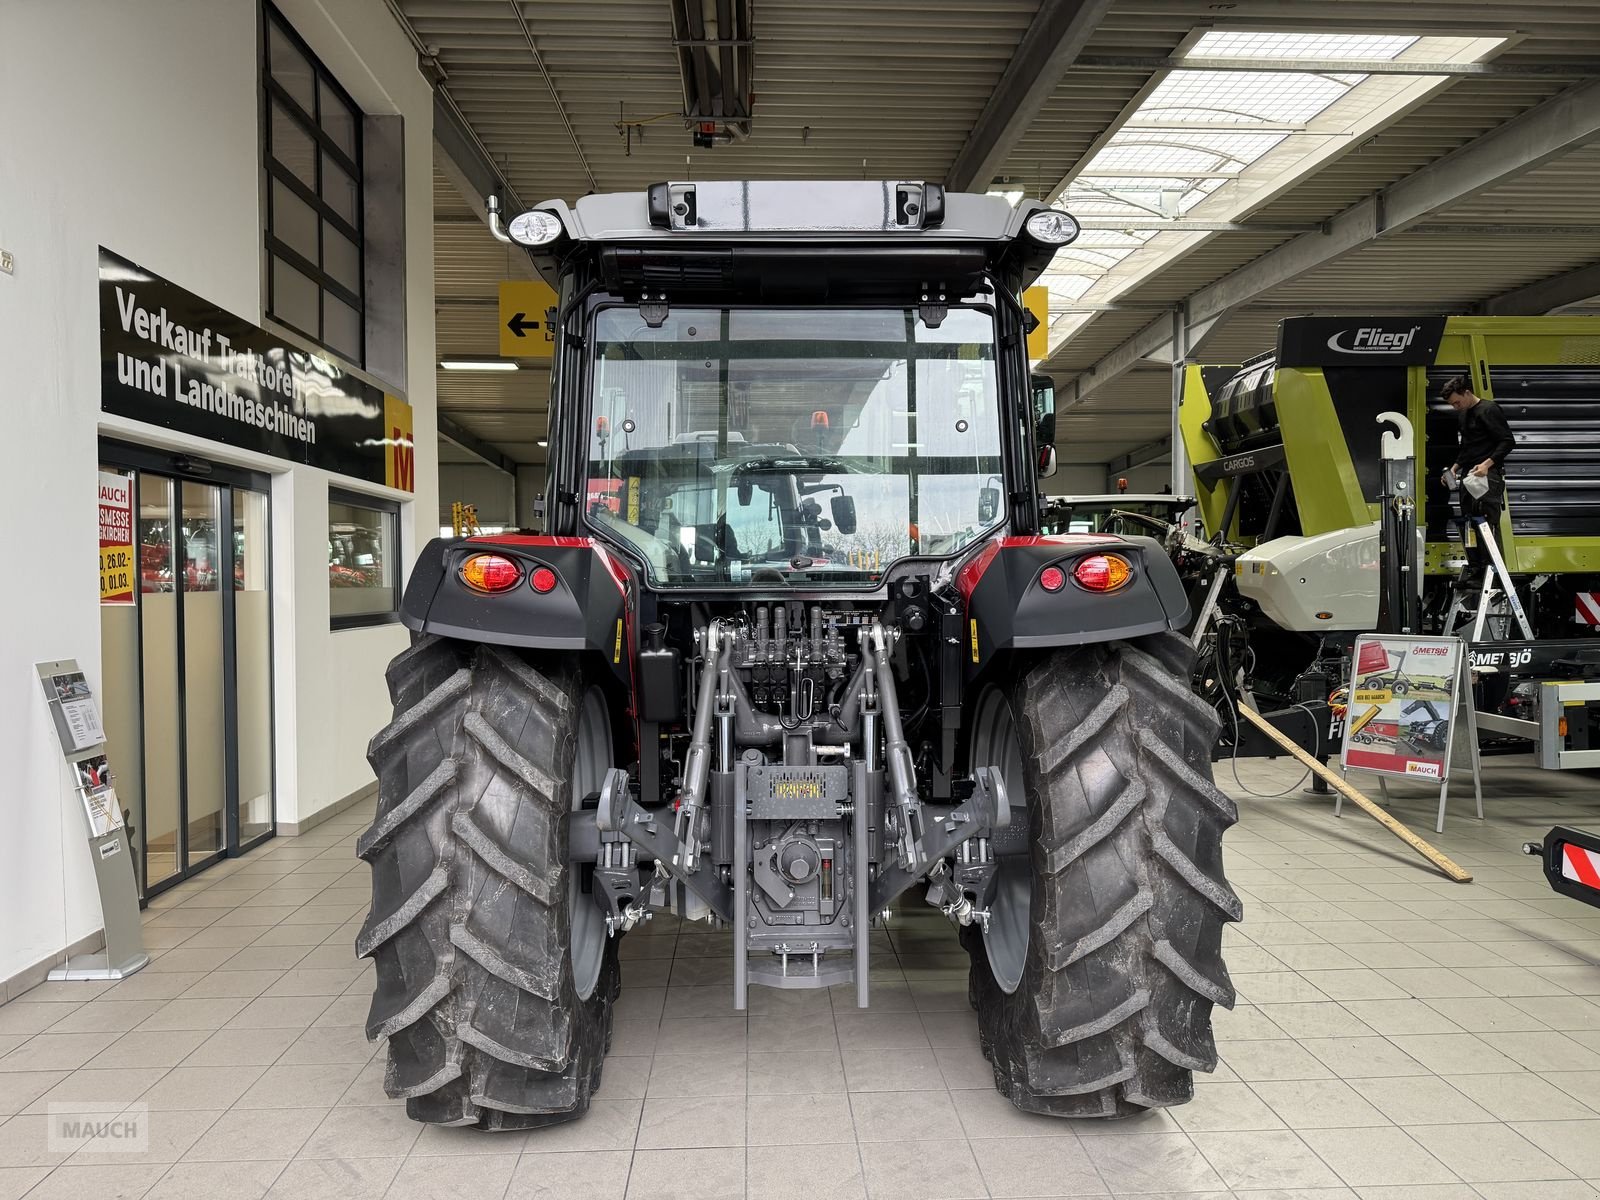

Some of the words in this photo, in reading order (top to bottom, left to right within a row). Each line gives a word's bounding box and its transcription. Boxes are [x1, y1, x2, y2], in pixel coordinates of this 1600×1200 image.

[115, 286, 211, 363] Verkauf
[216, 333, 307, 404] Traktoren
[1354, 328, 1416, 350] Fliegl
[117, 352, 167, 397] und
[174, 363, 316, 444] Landmaschinen
[393, 427, 414, 493] M
[1223, 456, 1255, 471] CARGOS
[99, 486, 126, 503] AUCH
[108, 573, 130, 590] 01.03.
[1418, 646, 1449, 656] METSJÖ
[1410, 765, 1437, 774] MAUCH
